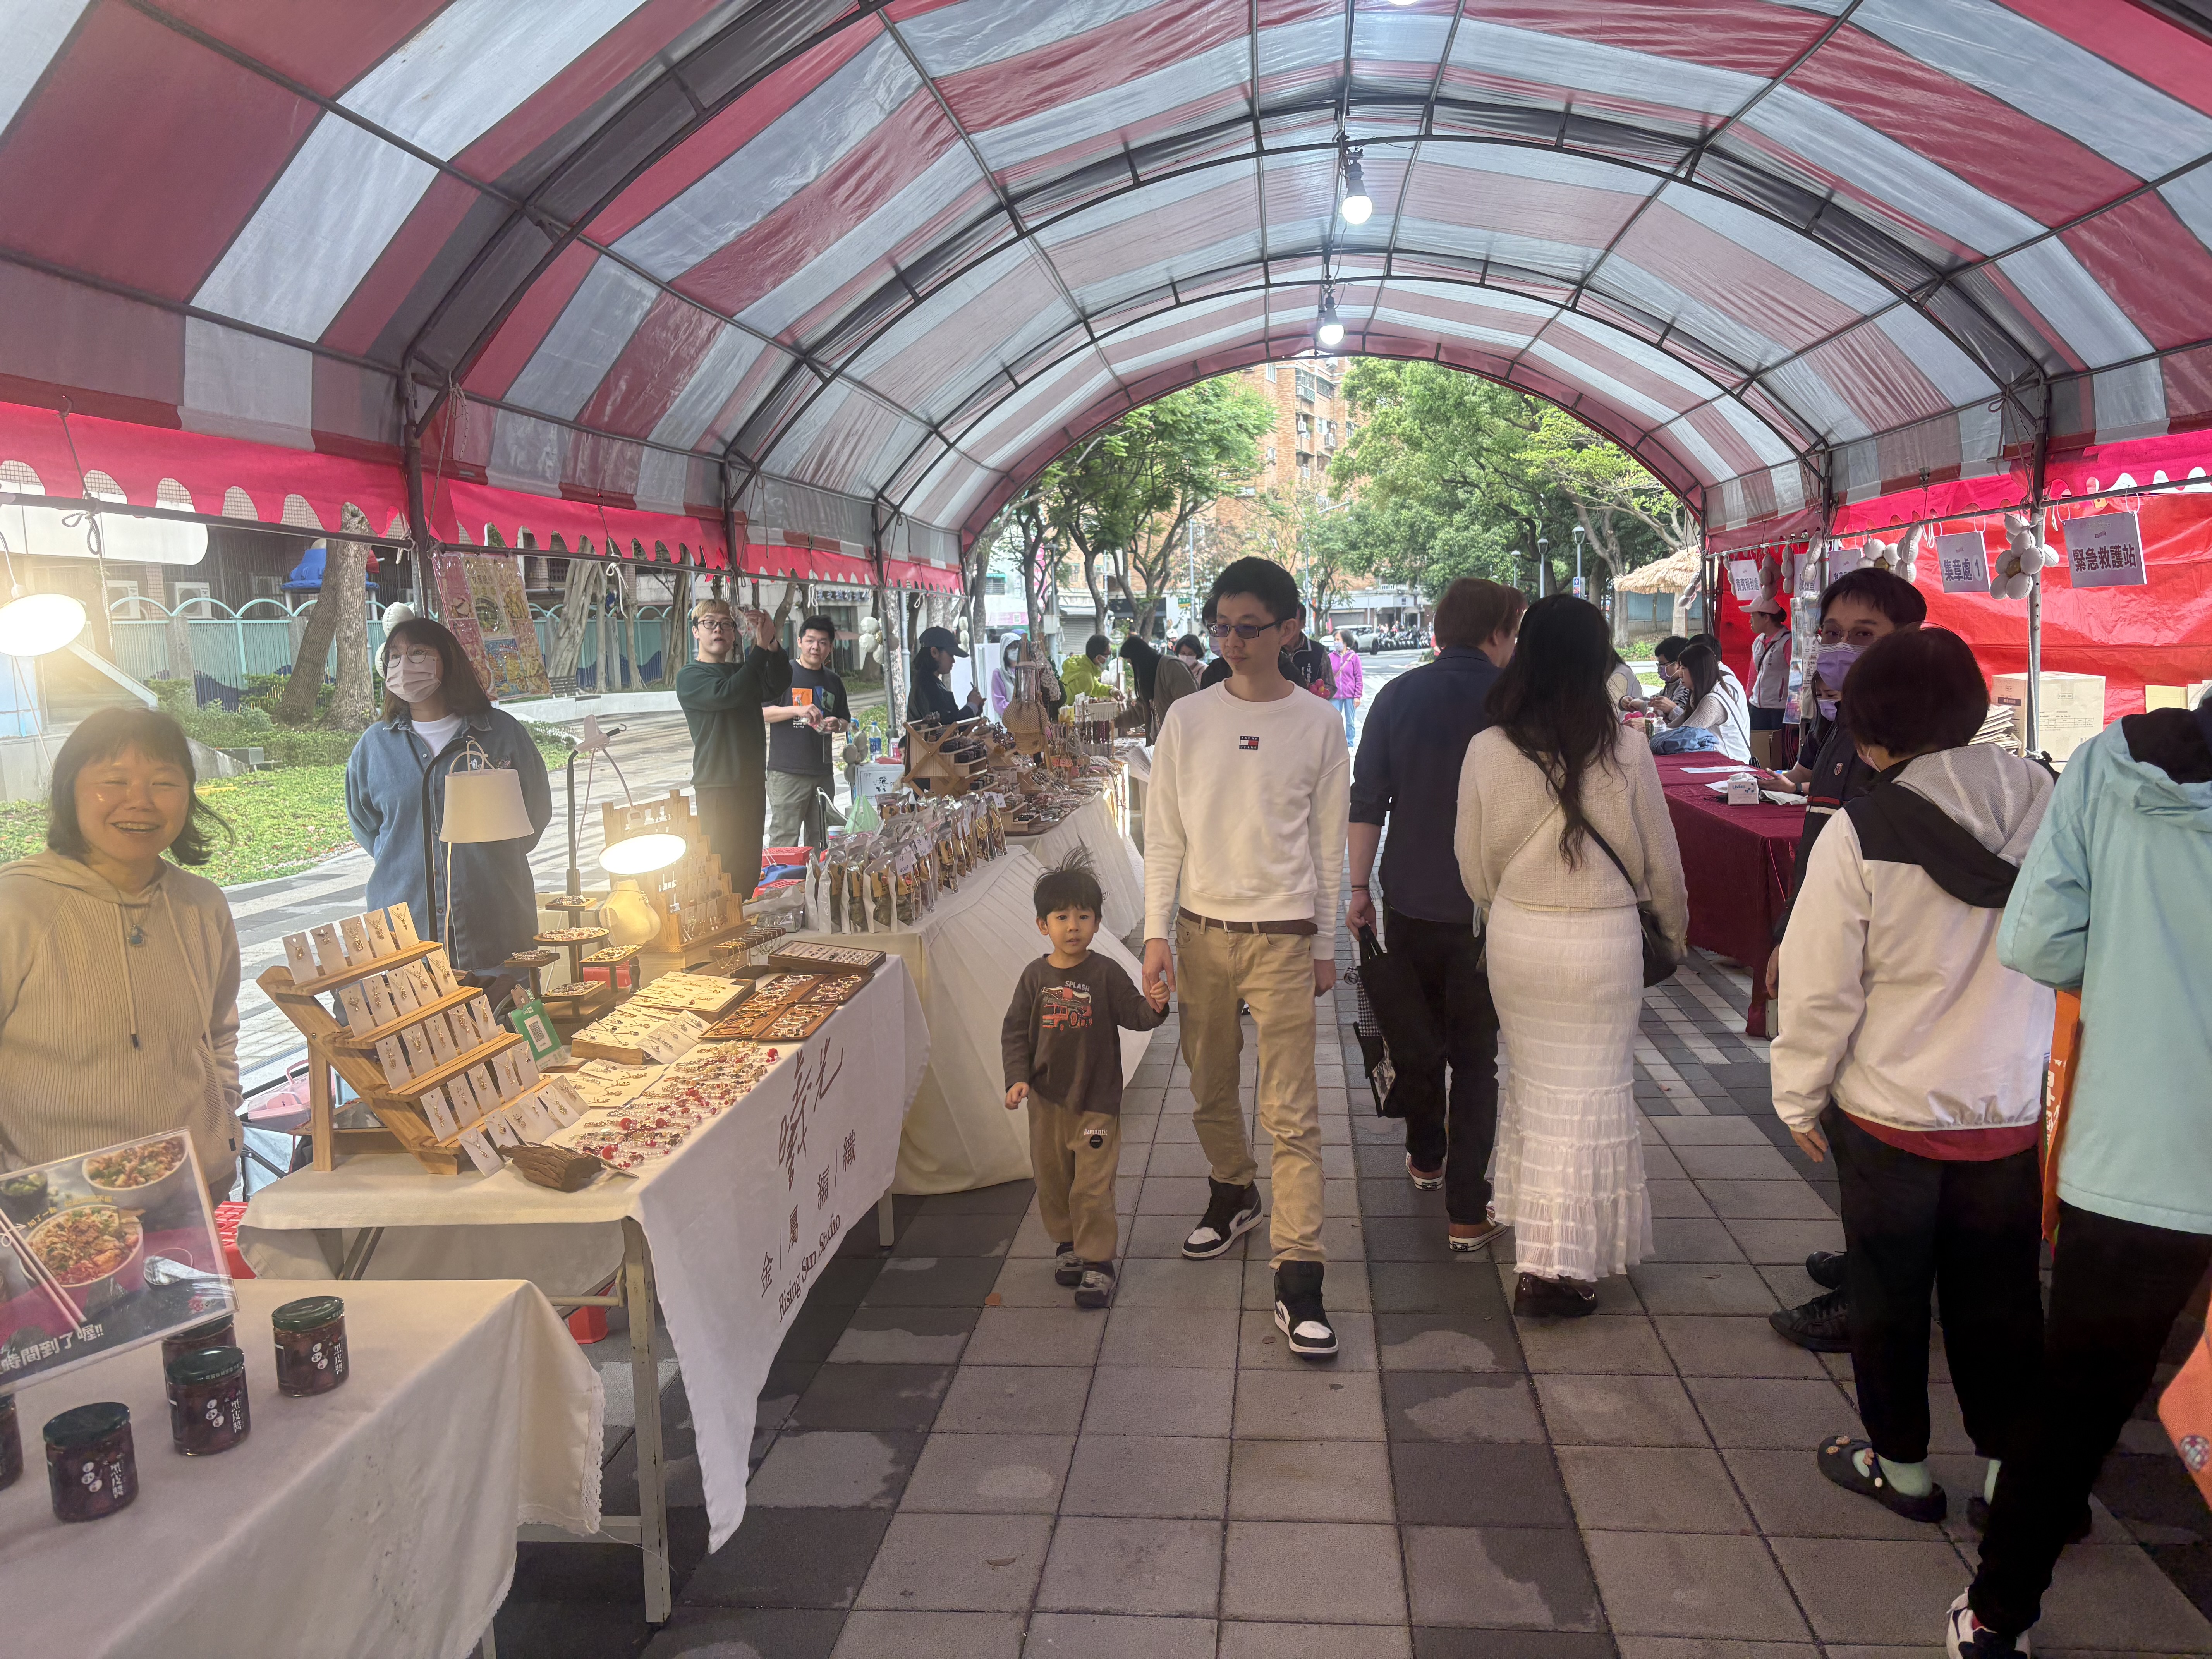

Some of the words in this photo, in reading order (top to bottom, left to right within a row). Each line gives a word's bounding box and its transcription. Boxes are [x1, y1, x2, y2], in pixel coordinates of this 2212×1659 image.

[1944, 558, 1972, 581] 集章處
[2072, 543, 2136, 572] 緊急救護站
[1065, 980, 1090, 992] SPLASH
[779, 1272, 801, 1322] Rising
[802, 1255, 816, 1283] Sun
[818, 1212, 840, 1258] Studio
[0, 1324, 104, 1374] 時間到了喔!!
